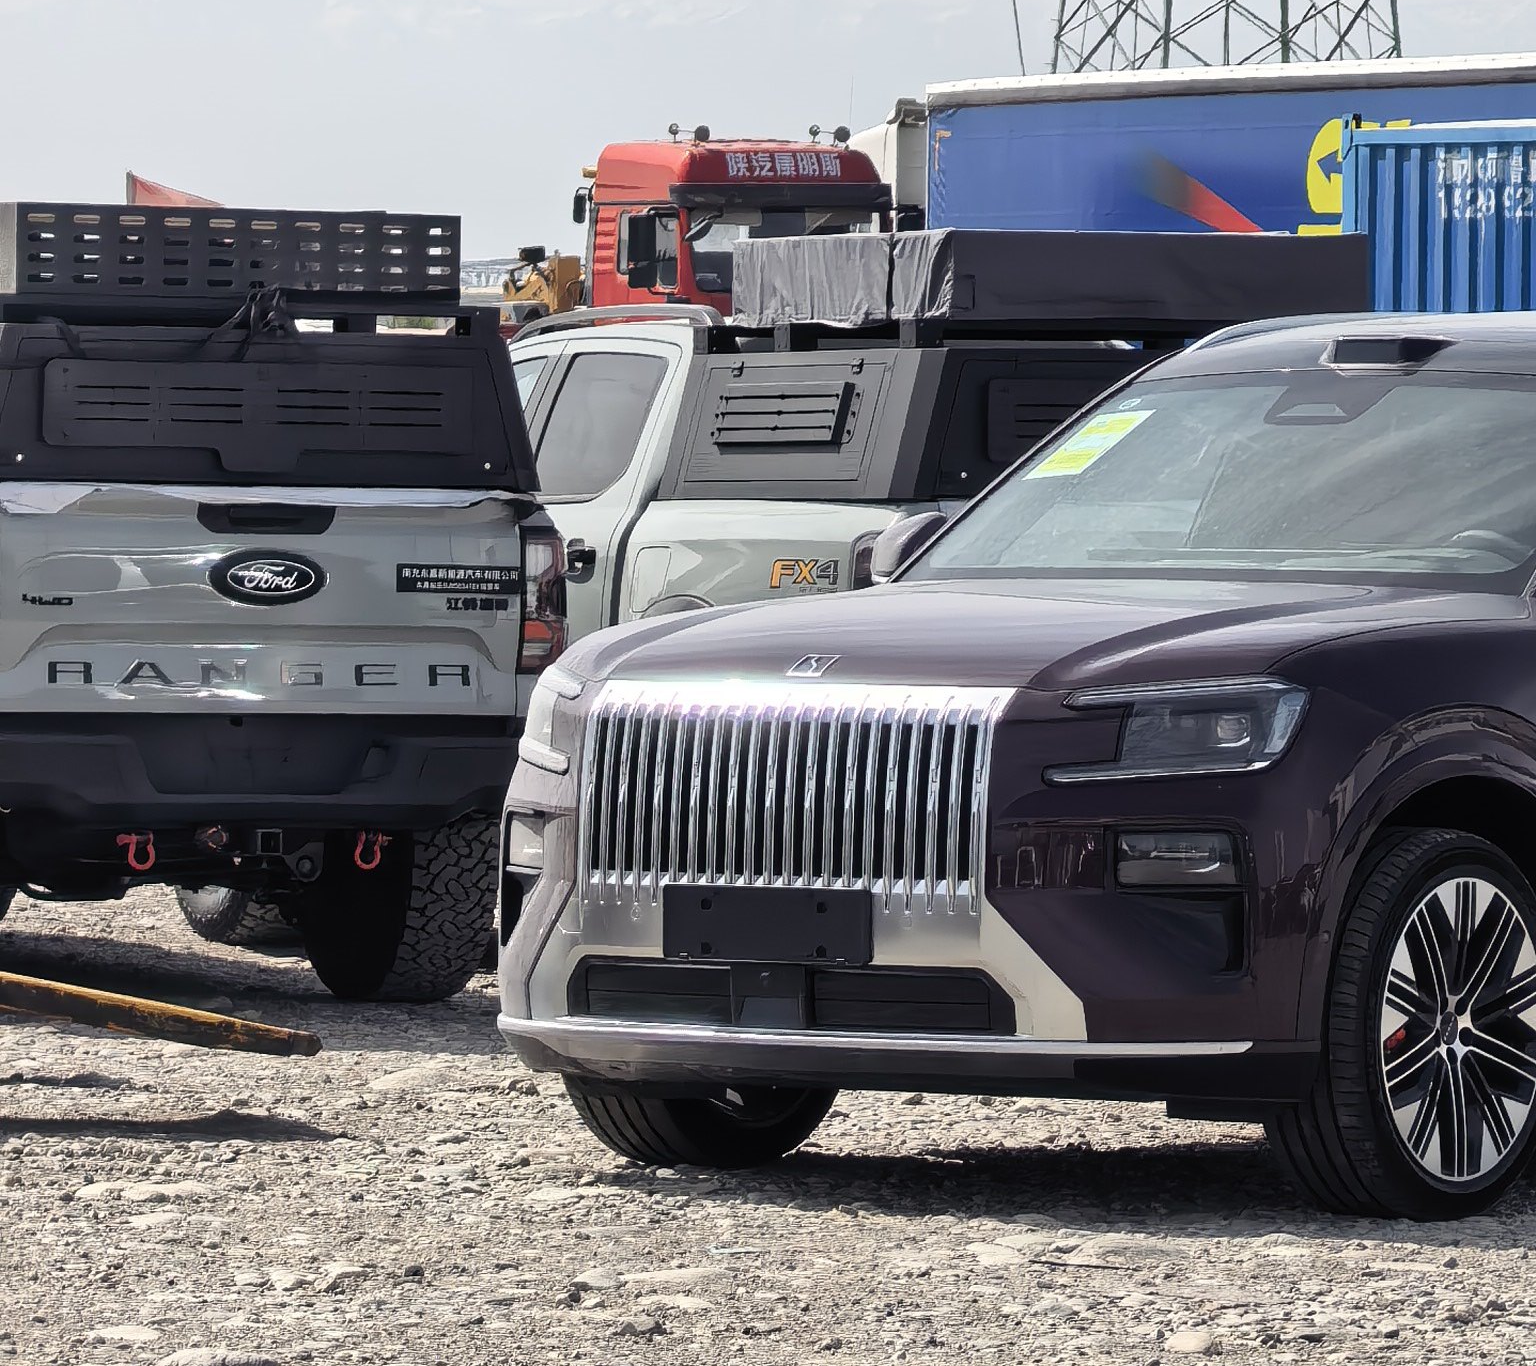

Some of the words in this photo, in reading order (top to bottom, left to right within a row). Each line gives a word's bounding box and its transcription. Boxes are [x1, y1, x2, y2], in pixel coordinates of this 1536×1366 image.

[725, 152, 841, 177] 陕汽康明斯
[244, 564, 298, 589] Ford
[769, 559, 839, 589] FX4
[47, 658, 471, 687] RANGER
